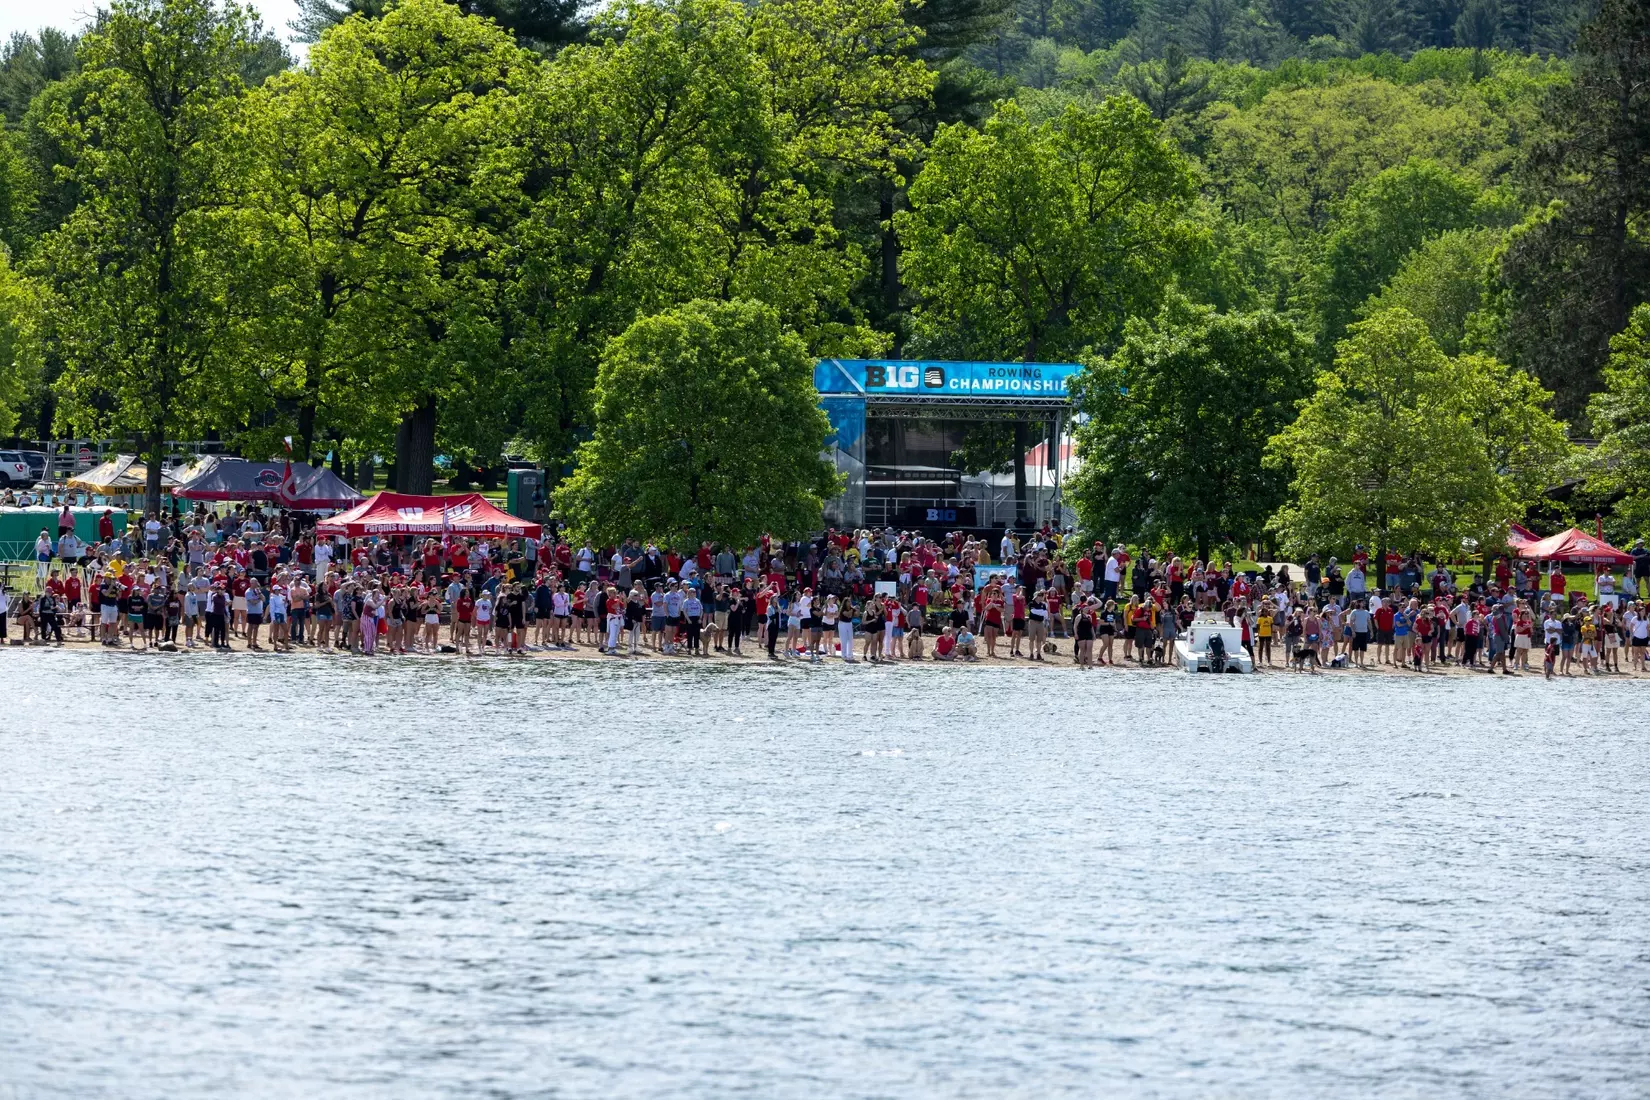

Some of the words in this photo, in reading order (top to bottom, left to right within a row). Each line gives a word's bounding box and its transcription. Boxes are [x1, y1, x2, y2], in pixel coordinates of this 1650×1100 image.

[988, 367, 1042, 378] ROWING
[114, 486, 139, 494] IOWA
[397, 507, 424, 521] W
[364, 523, 397, 533] Parents
[398, 523, 407, 532] of
[408, 523, 453, 532] Wisconsn
